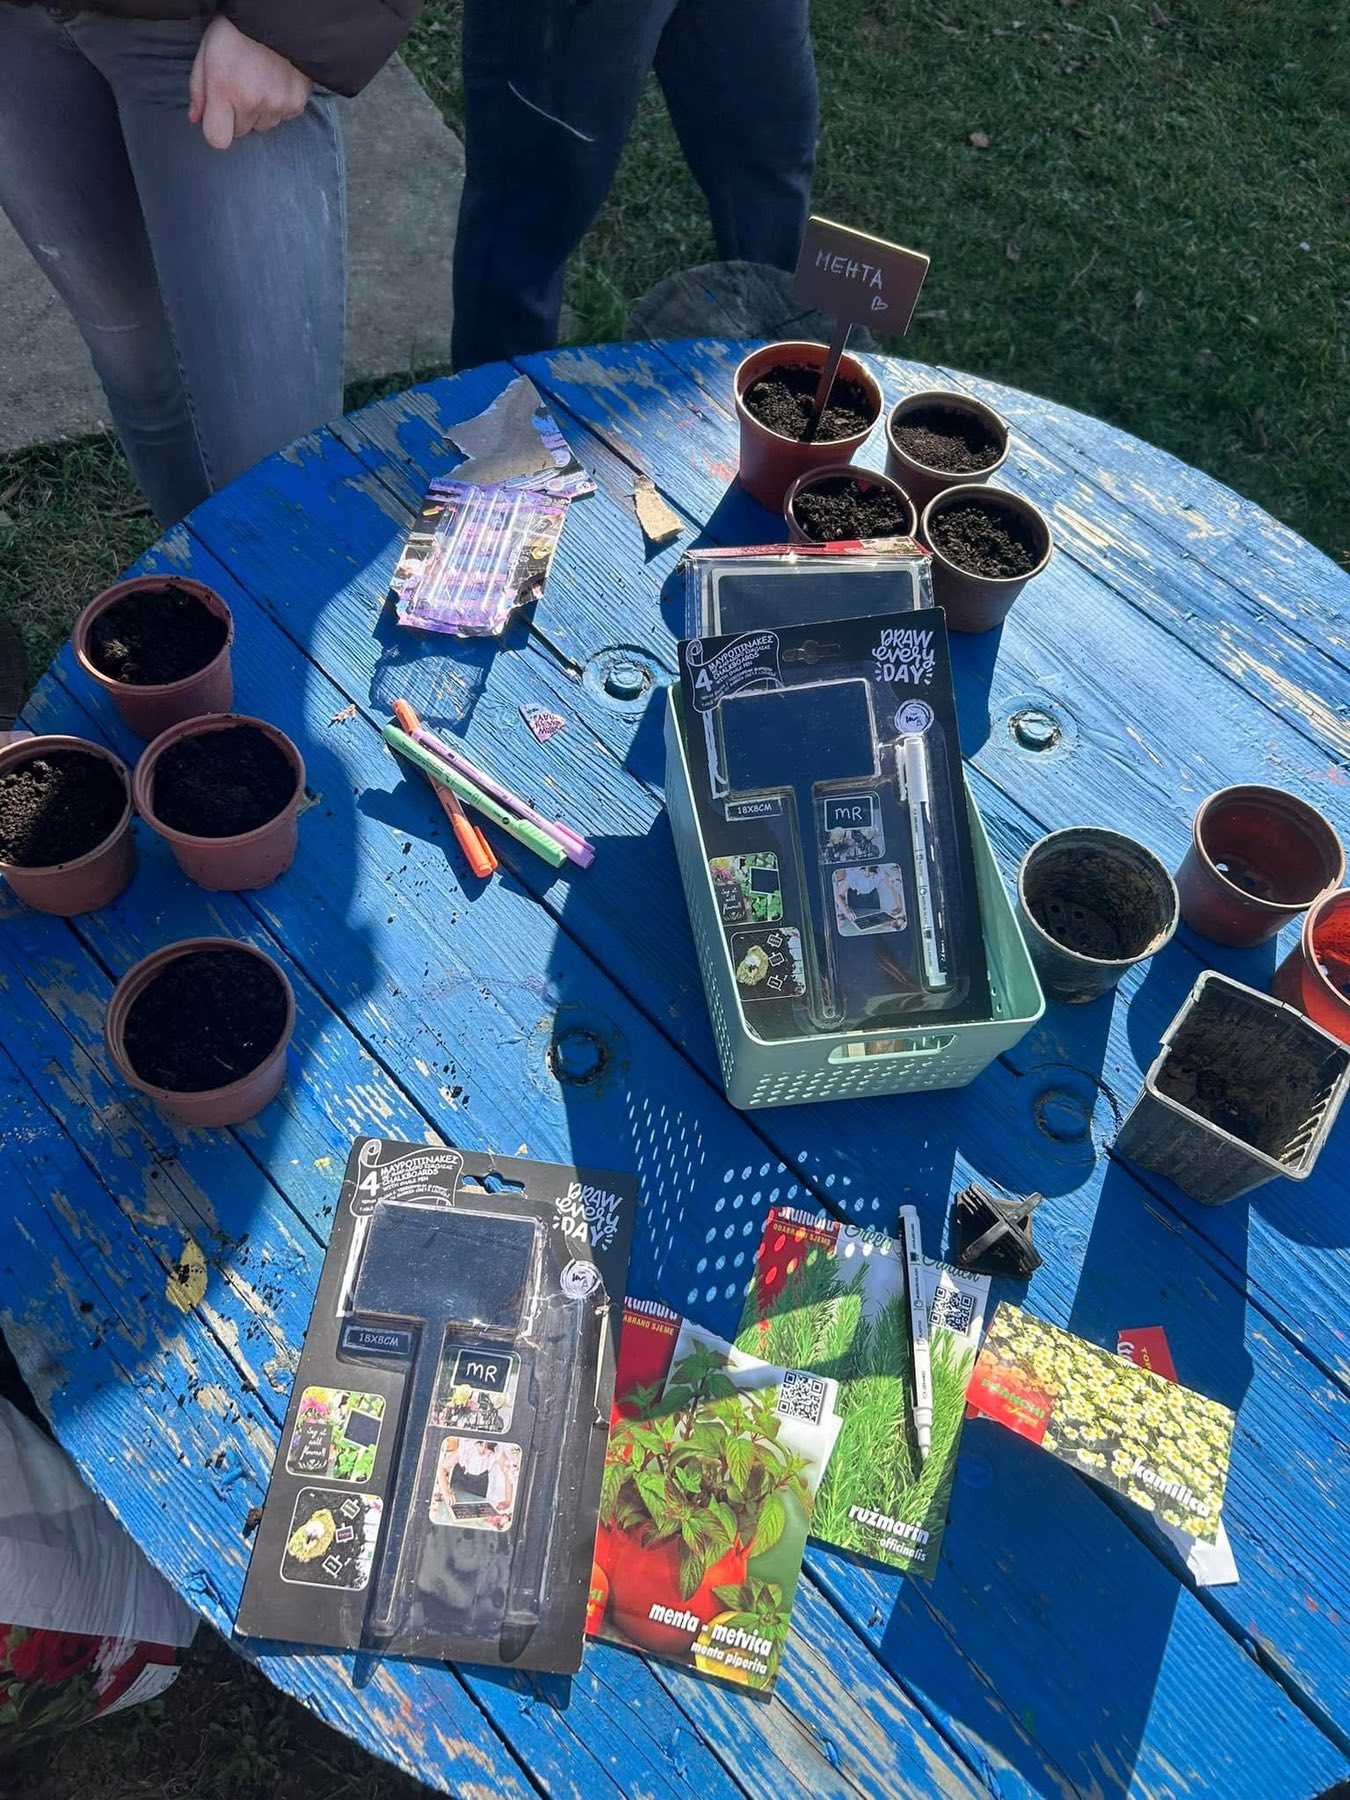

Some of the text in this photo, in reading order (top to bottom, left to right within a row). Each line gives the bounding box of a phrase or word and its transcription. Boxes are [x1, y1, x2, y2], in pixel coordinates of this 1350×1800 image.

[815, 249, 883, 290] МЕНТА
[880, 628, 934, 648] DRAW
[713, 652, 760, 680] CHALKBOARDS
[872, 646, 936, 669] every
[694, 668, 714, 692] 4
[882, 663, 924, 685] DAY
[359, 1171, 380, 1197] 4
[382, 1168, 439, 1186] CHALKBOARDS
[567, 1182, 624, 1213] DRAW
[555, 1197, 620, 1237] every
[561, 1216, 604, 1247] DAY
[358, 1332, 399, 1347] 18X8CM
[651, 1322, 675, 1336] SJEME
[1132, 1457, 1210, 1518] kamilica
[848, 1504, 930, 1545] ružmarin
[880, 1537, 927, 1561] officinalis
[649, 1603, 700, 1632] menta
[711, 1623, 773, 1657] metvica
[691, 1641, 768, 1675] menta piperita
